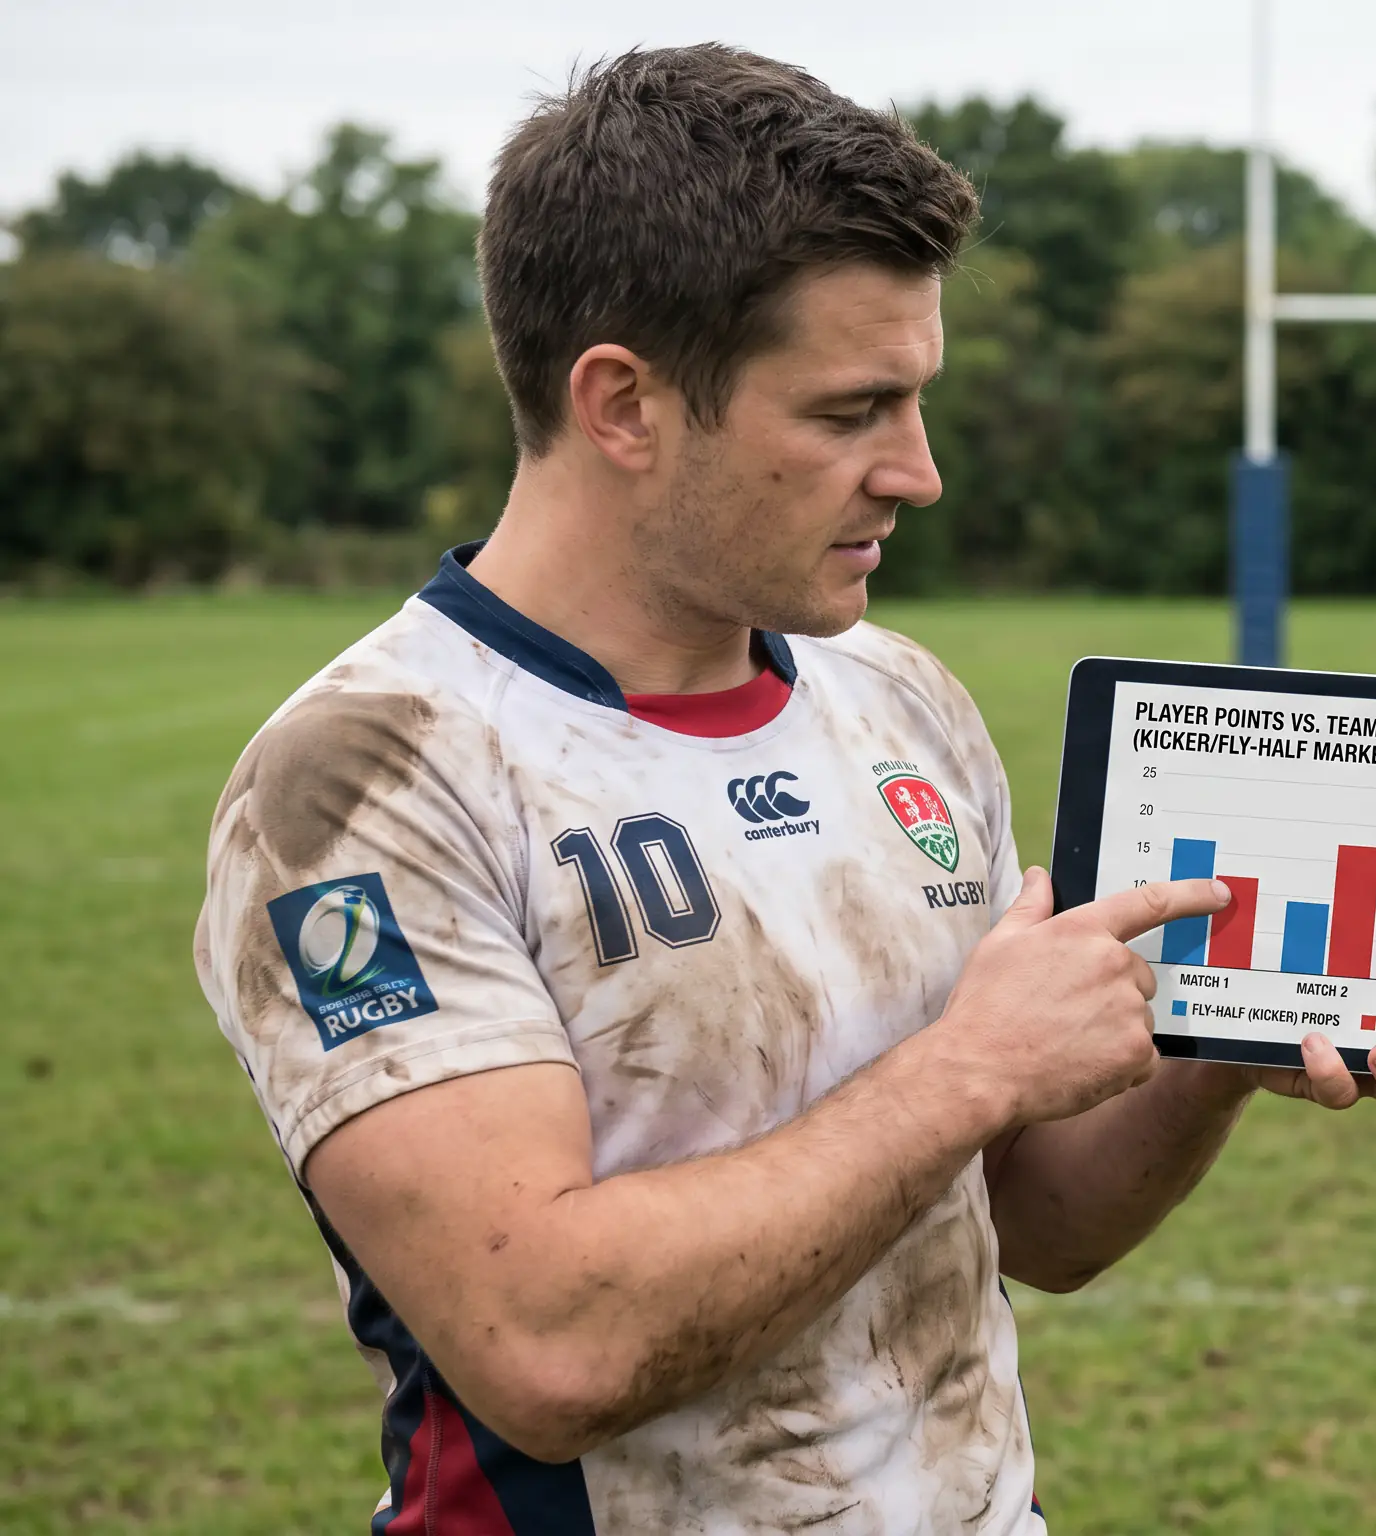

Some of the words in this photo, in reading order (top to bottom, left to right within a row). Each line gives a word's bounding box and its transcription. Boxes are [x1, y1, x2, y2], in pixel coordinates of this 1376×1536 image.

[1135, 702, 1208, 725] PLAYER
[1214, 707, 1285, 731] POINTS
[1291, 713, 1320, 733] VS.
[1133, 728, 1308, 759] (KICKER/FLY-HALF
[1143, 766, 1157, 778] 25
[1139, 804, 1153, 815] 20
[744, 820, 819, 841] canterbury
[1137, 841, 1150, 853] 15
[550, 812, 722, 967] 10
[921, 881, 986, 908] RUGBY
[1180, 973, 1220, 987] MATCH
[1223, 977, 1229, 988] 1
[1296, 982, 1337, 997] MATCH
[1340, 986, 1348, 998] 2
[323, 986, 418, 1038] RUGBY
[1192, 1003, 1245, 1019] FLY-HALF
[1248, 1008, 1298, 1025] (KICKER)
[1301, 1012, 1340, 1026] PROPS
